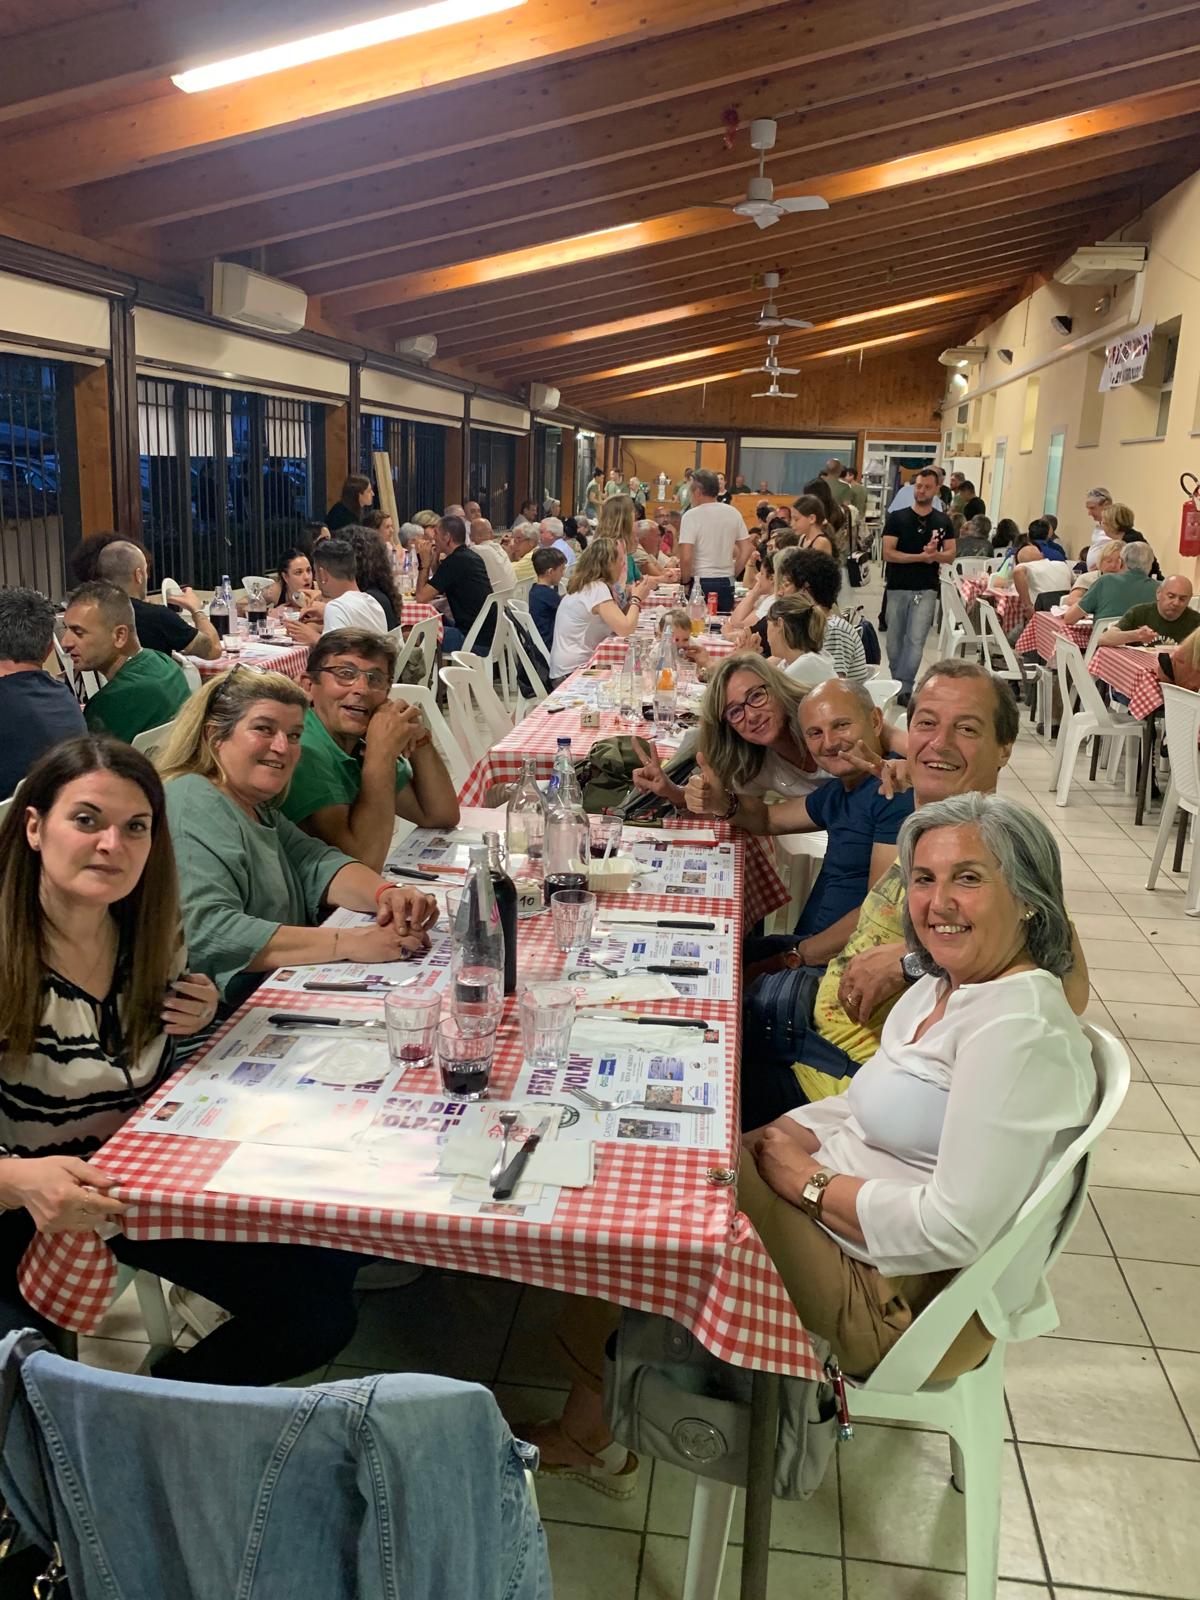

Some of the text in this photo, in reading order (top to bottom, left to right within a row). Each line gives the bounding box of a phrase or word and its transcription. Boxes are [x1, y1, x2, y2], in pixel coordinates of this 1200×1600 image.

[519, 895, 535, 907] 10
[526, 1069, 558, 1096] FESTA
[427, 1101, 468, 1116] DEI
